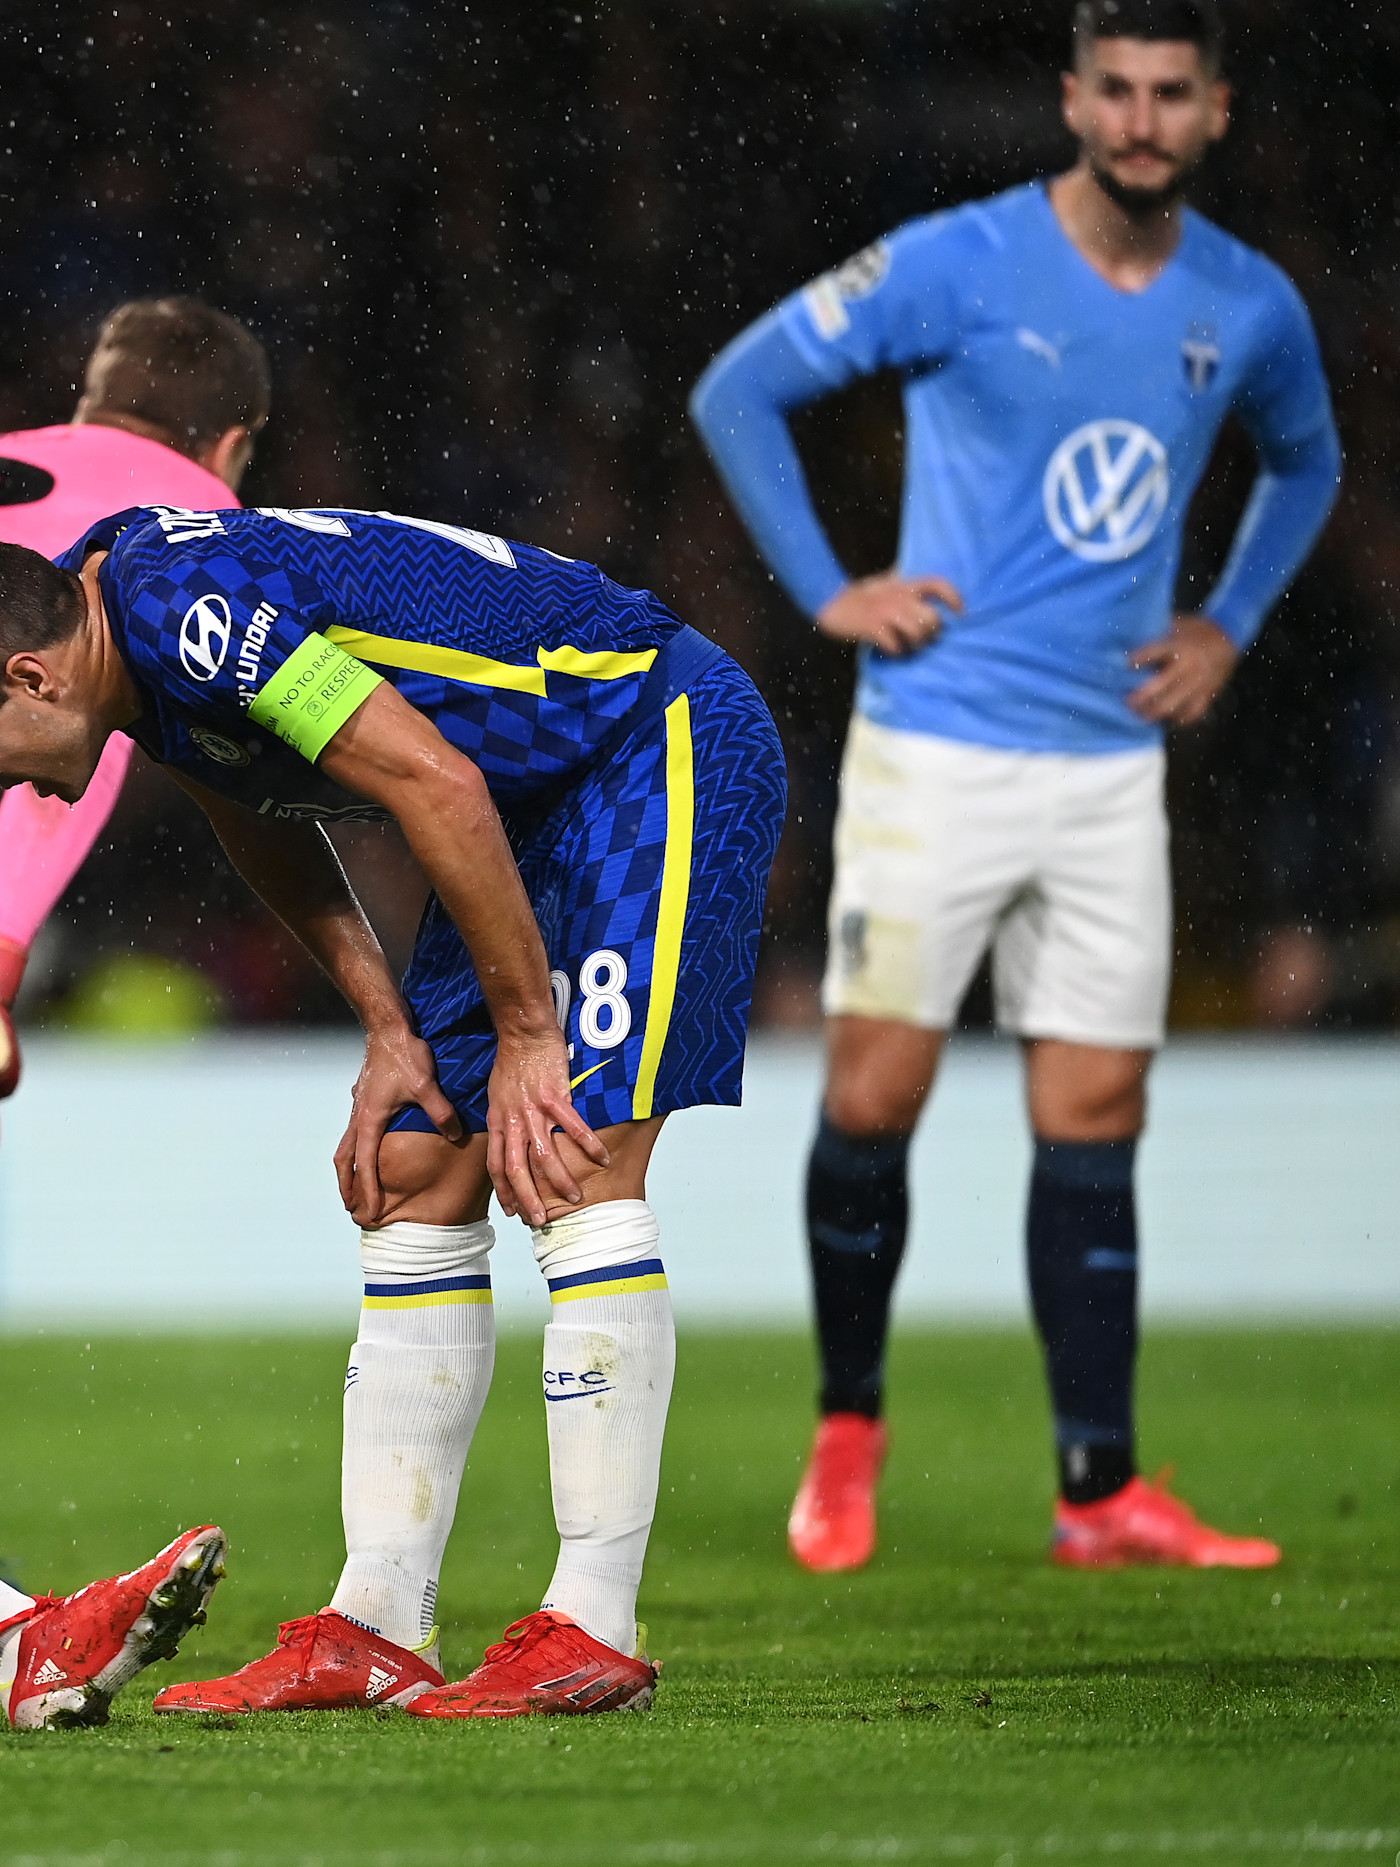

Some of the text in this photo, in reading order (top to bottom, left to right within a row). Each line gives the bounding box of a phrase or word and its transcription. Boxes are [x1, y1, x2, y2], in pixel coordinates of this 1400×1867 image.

[279, 688, 299, 709] NO
[296, 670, 315, 688] TO
[312, 643, 341, 671] RACIS
[544, 1370, 608, 1386] CFC
[33, 1671, 68, 1686] adidas
[365, 1674, 399, 1700] adidas
